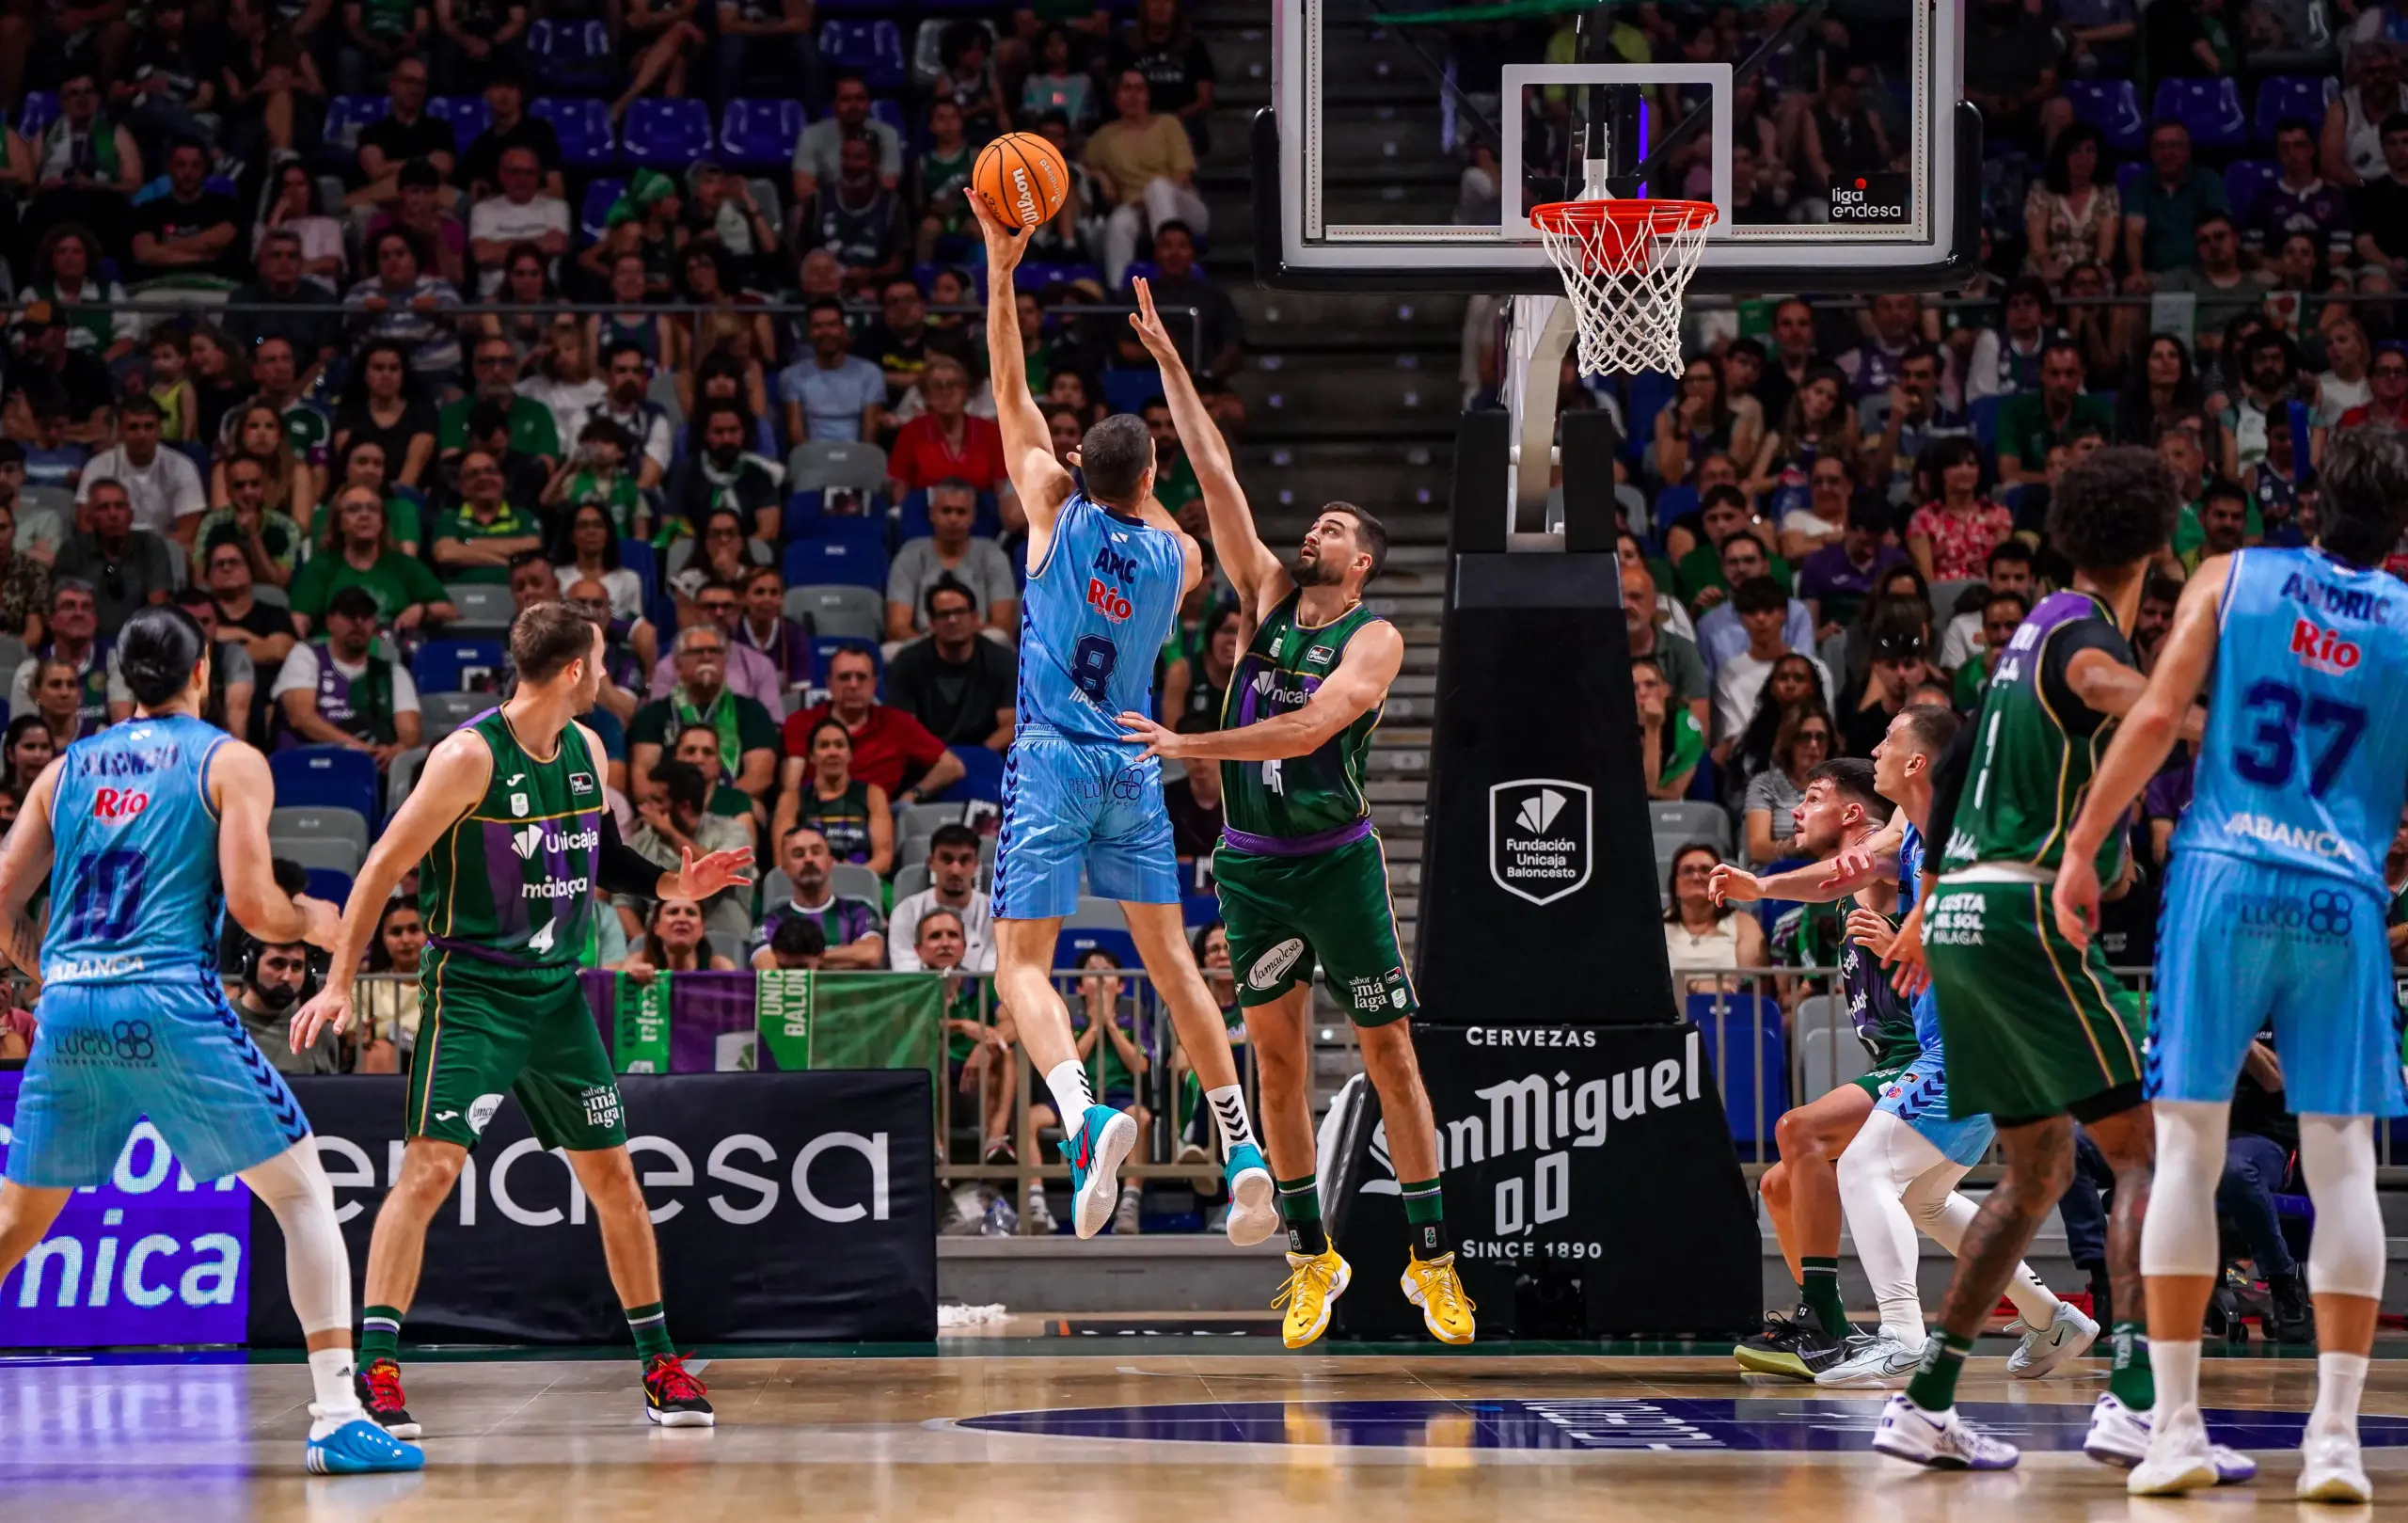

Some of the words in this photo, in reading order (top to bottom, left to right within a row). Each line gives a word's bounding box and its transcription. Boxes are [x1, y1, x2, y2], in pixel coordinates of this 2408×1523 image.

[1012, 167, 1039, 226] Wilson
[1831, 186, 1863, 204] liga
[1831, 202, 1901, 218] endesa
[2279, 572, 2391, 627] ANDRIC
[1069, 633, 1118, 705] 8
[1271, 685, 1315, 707] nicaj
[2231, 676, 2368, 801] 37
[1506, 837, 1576, 851] Fundación
[2224, 812, 2354, 863] ABANCA
[1516, 853, 1567, 868] Unicaja
[1506, 866, 1576, 879] Baloncesto
[67, 849, 150, 942] 10
[1252, 940, 1301, 987] famadesa
[1348, 976, 1370, 987] sabor
[1356, 976, 1386, 997] má
[1354, 993, 1389, 1013] laga
[1465, 1026, 1597, 1049] CERVEZAS
[580, 1086, 606, 1098] sabor
[589, 1086, 618, 1111] má
[585, 1106, 620, 1128] laga
[1462, 1238, 1535, 1259] SINCE
[1544, 1241, 1603, 1260] 1890
